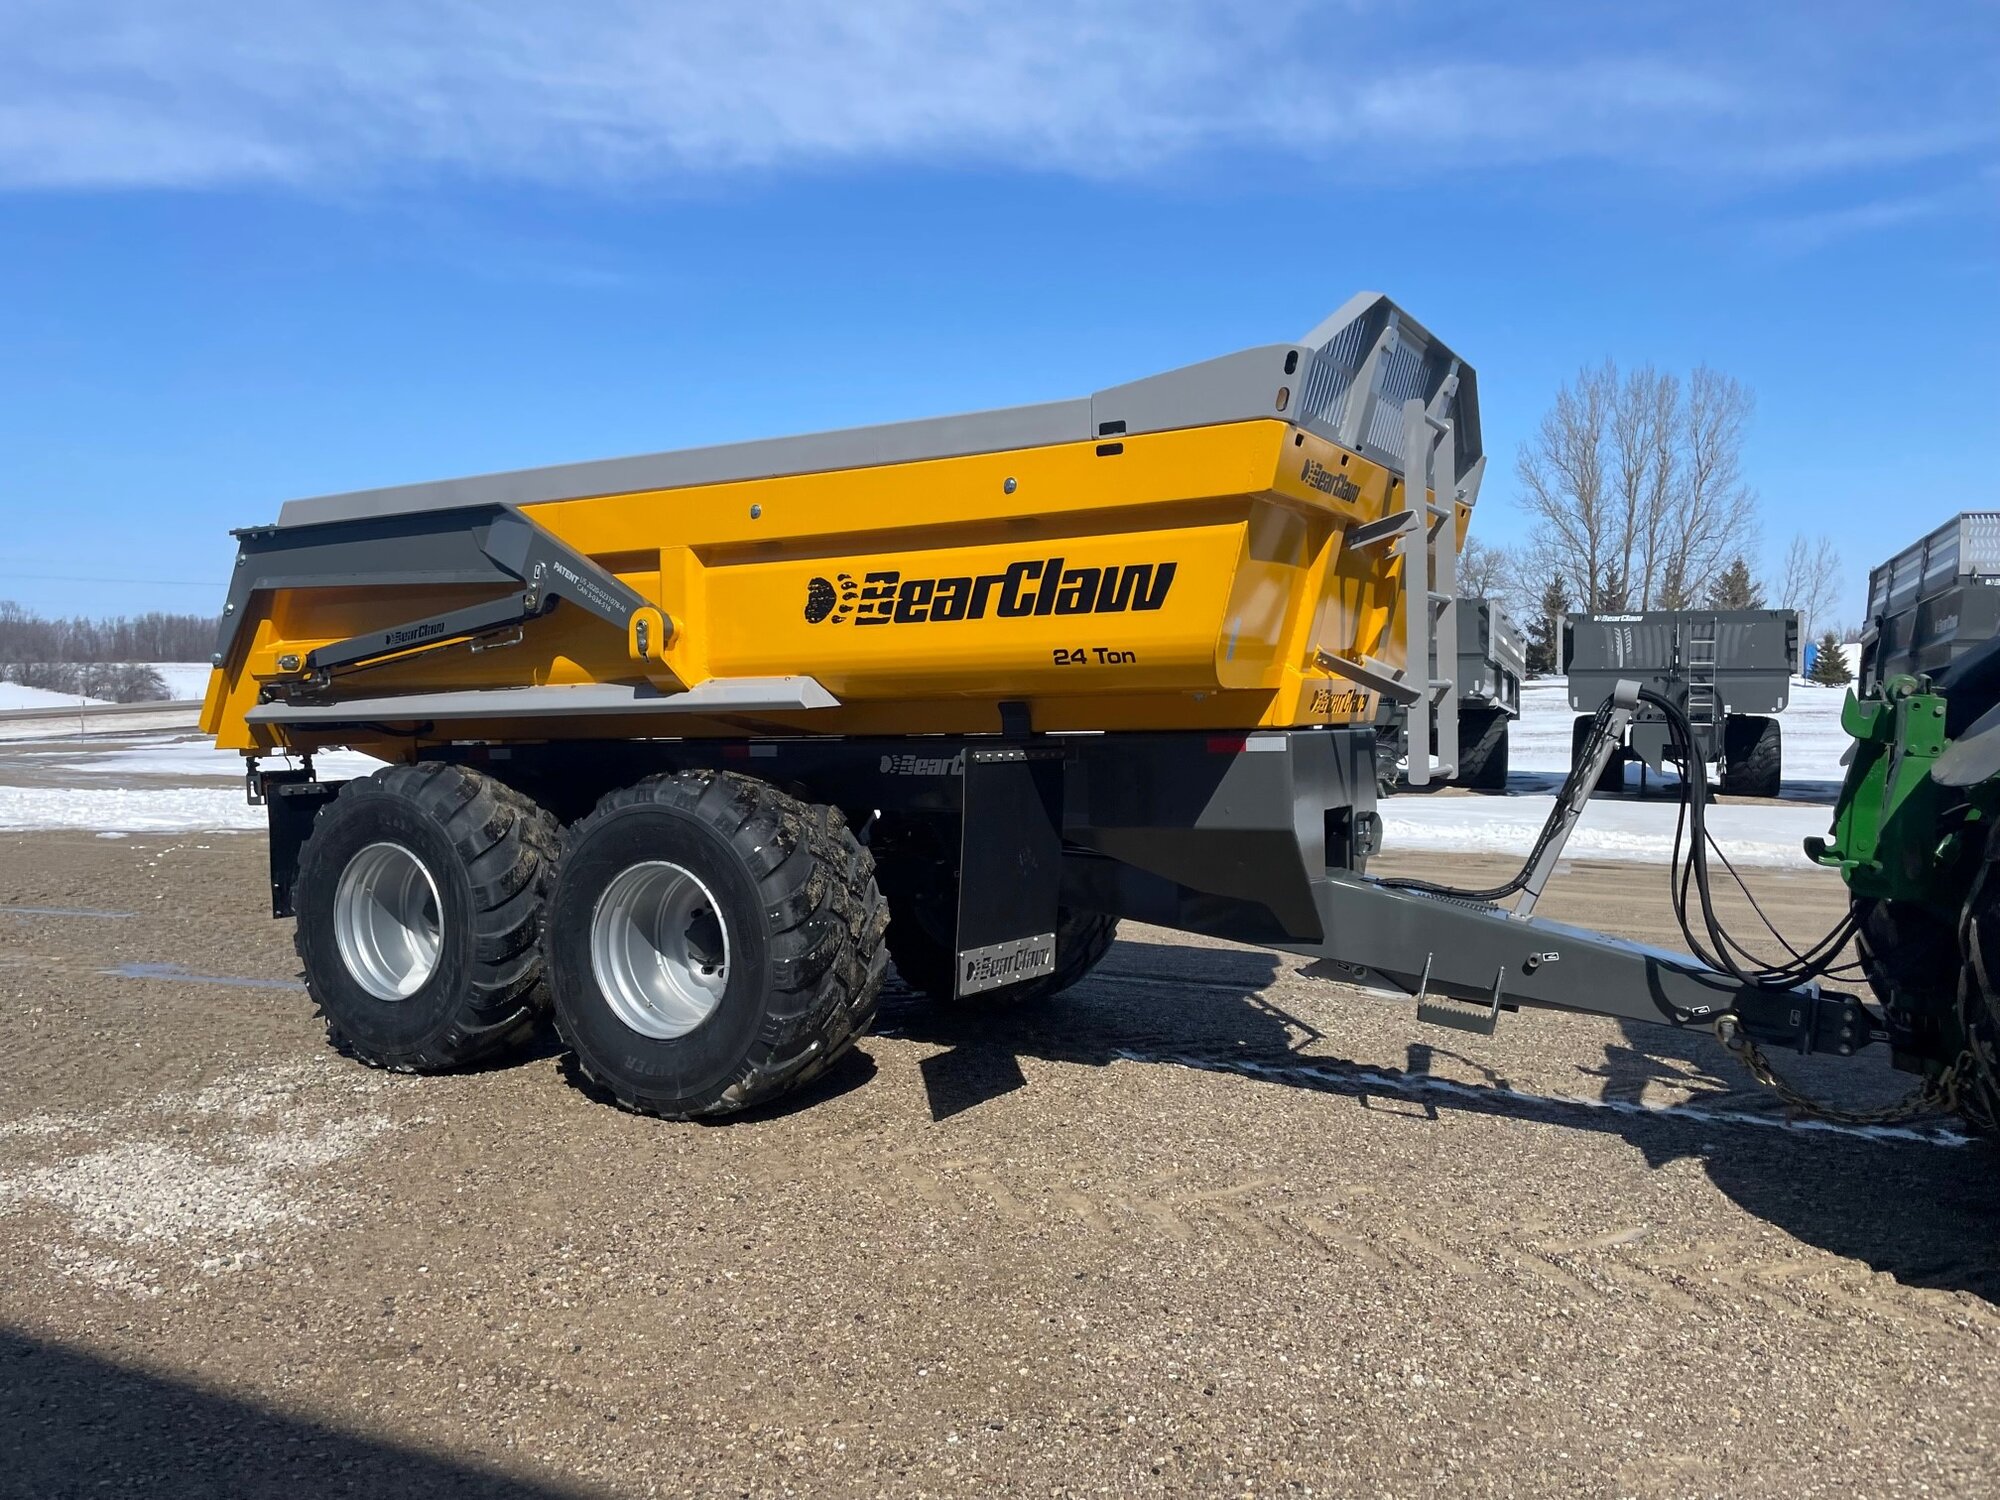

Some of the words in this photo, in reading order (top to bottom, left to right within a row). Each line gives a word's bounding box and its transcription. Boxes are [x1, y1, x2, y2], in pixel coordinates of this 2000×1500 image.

[1309, 462, 1361, 504] BearClaw
[553, 561, 580, 585] PATENT
[579, 576, 588, 585] US
[576, 584, 588, 596] CAN
[855, 557, 1178, 626] BearClaw
[1601, 614, 1643, 622] BearClaw
[391, 622, 445, 644] BearClaw
[1053, 648, 1087, 666] 24
[1092, 647, 1136, 665] Ton
[1318, 688, 1370, 713] BearClaw
[979, 947, 1050, 980] BearClaw
